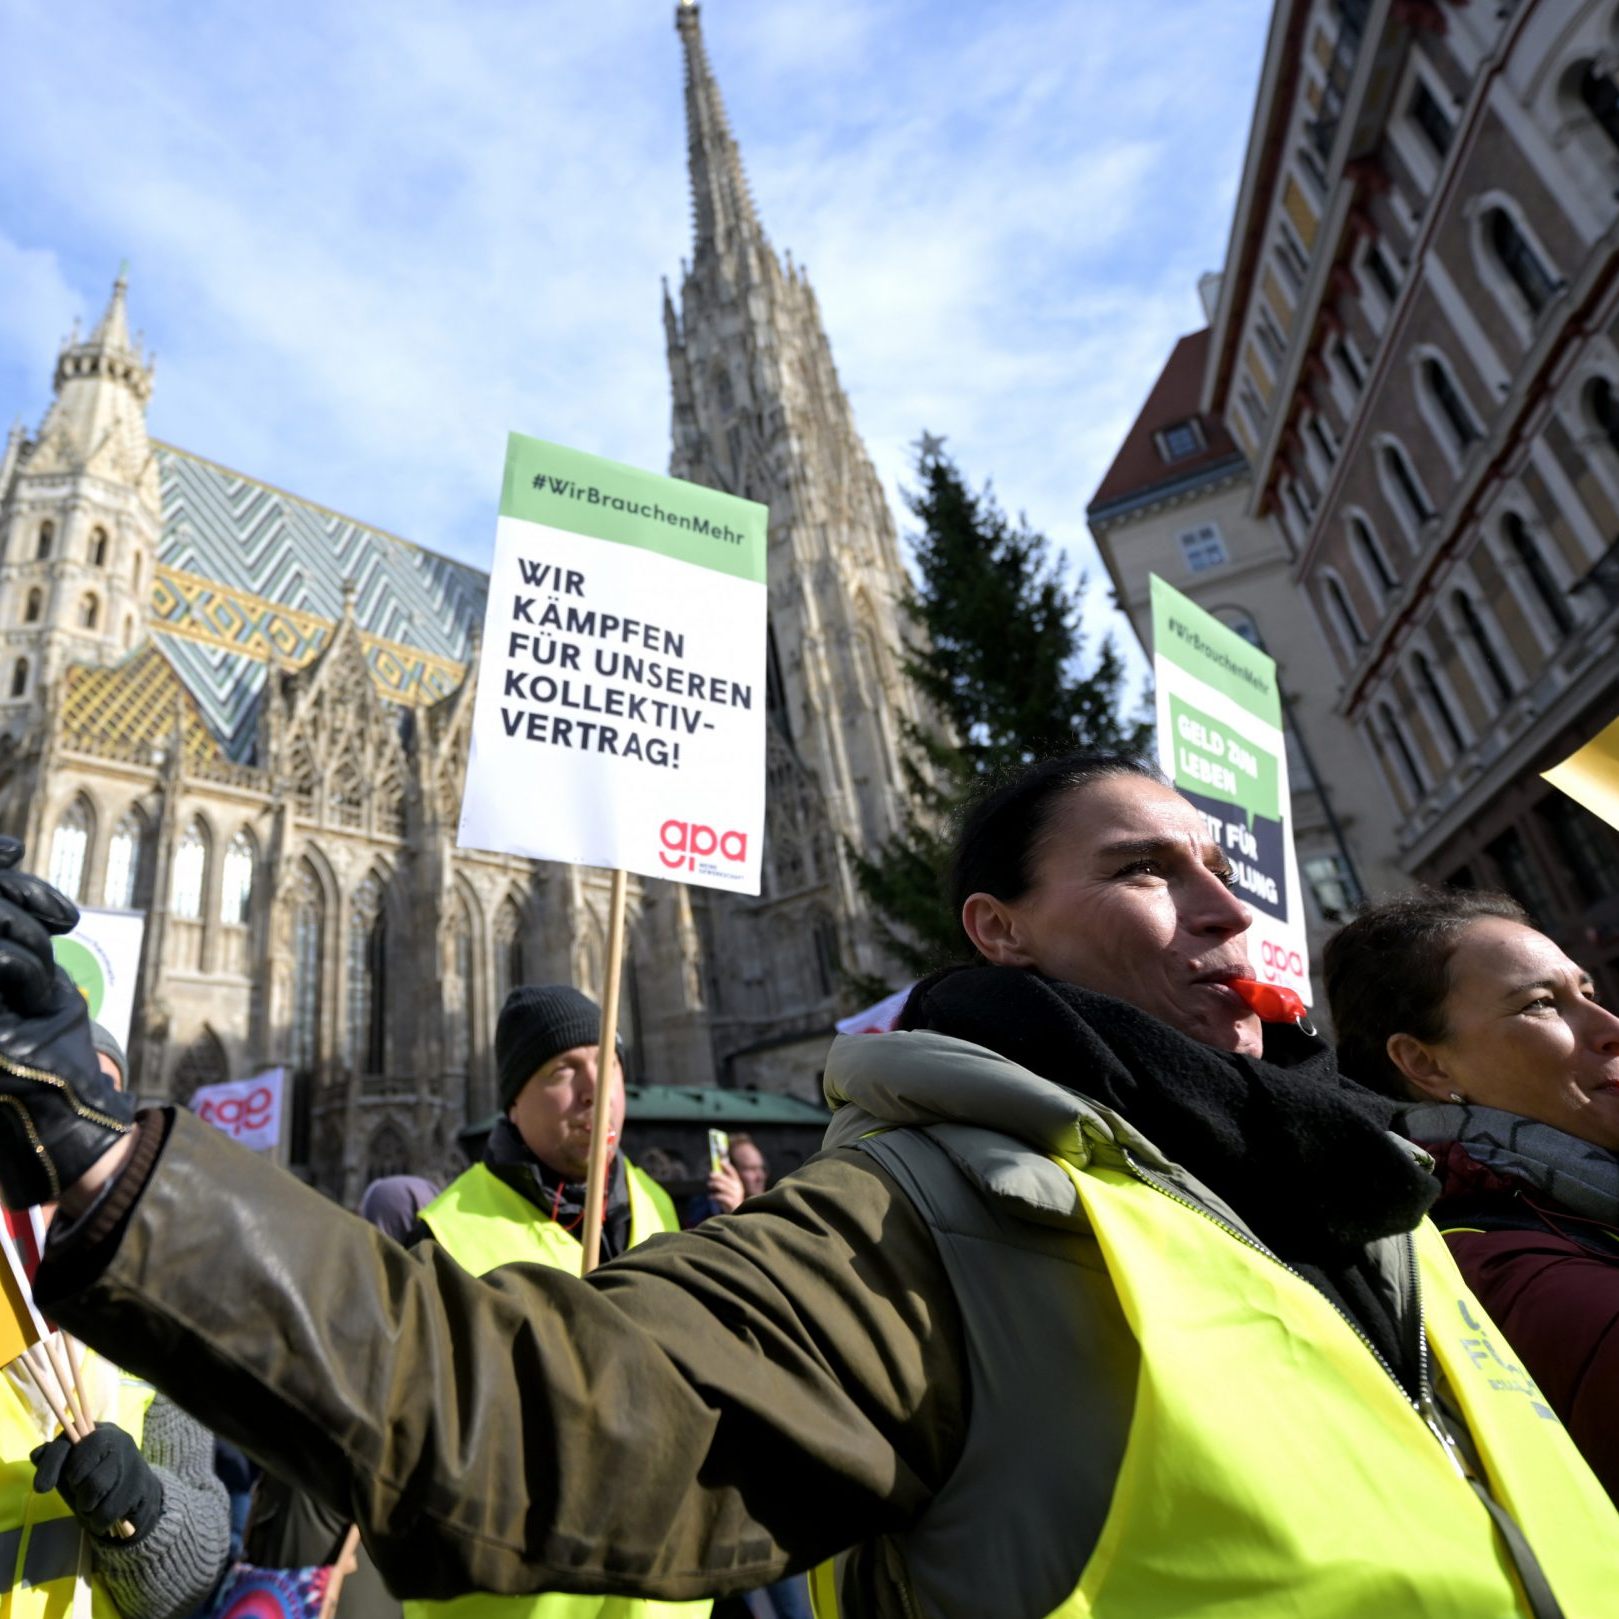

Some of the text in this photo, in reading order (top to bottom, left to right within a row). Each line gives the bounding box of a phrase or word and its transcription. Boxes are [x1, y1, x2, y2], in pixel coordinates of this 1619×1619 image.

[532, 473, 745, 545] #WirBrauchenMehr
[518, 558, 585, 598] WIR
[513, 595, 684, 658] KÄMPFEN
[508, 631, 752, 710] FÜR UNSEREN
[504, 669, 715, 735] KOLLEKTIV-
[501, 708, 680, 769] VERTRAG!
[1177, 714, 1258, 779] GELD ZUM
[1180, 746, 1237, 796] LEBEN
[659, 819, 747, 872] gpa
[1225, 822, 1259, 861] FÜR
[1262, 940, 1304, 985] gpa
